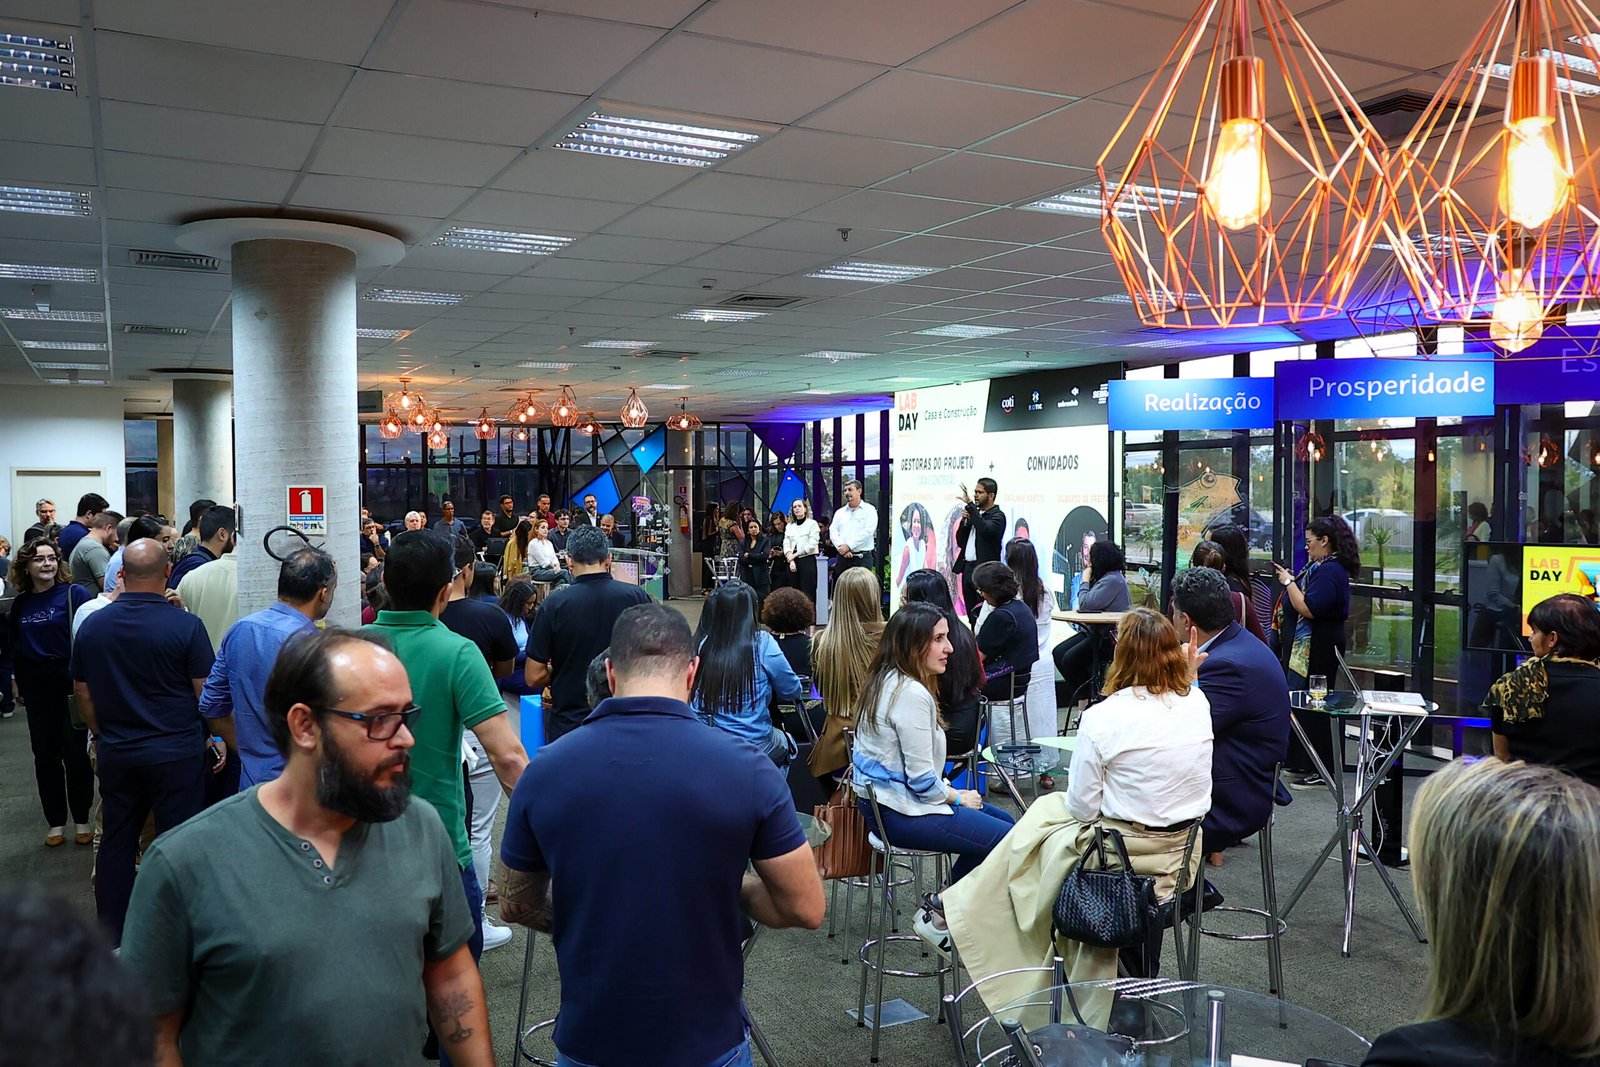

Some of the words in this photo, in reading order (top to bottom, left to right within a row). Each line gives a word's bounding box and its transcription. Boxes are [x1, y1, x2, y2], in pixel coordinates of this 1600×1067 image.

[1309, 370, 1486, 400] Prosperidade
[898, 392, 917, 411] LAB
[1001, 395, 1014, 409] coti
[1144, 391, 1261, 415] Realização
[924, 410, 938, 421] Casa
[943, 405, 978, 420] Construção
[898, 412, 919, 431] DAY
[900, 457, 932, 472] GESTORAS
[933, 457, 942, 470] DO
[943, 455, 974, 470] PROJETO
[1027, 455, 1079, 471] CONVIDADOS
[1530, 558, 1560, 569] LAB
[1530, 570, 1562, 581] DAY
